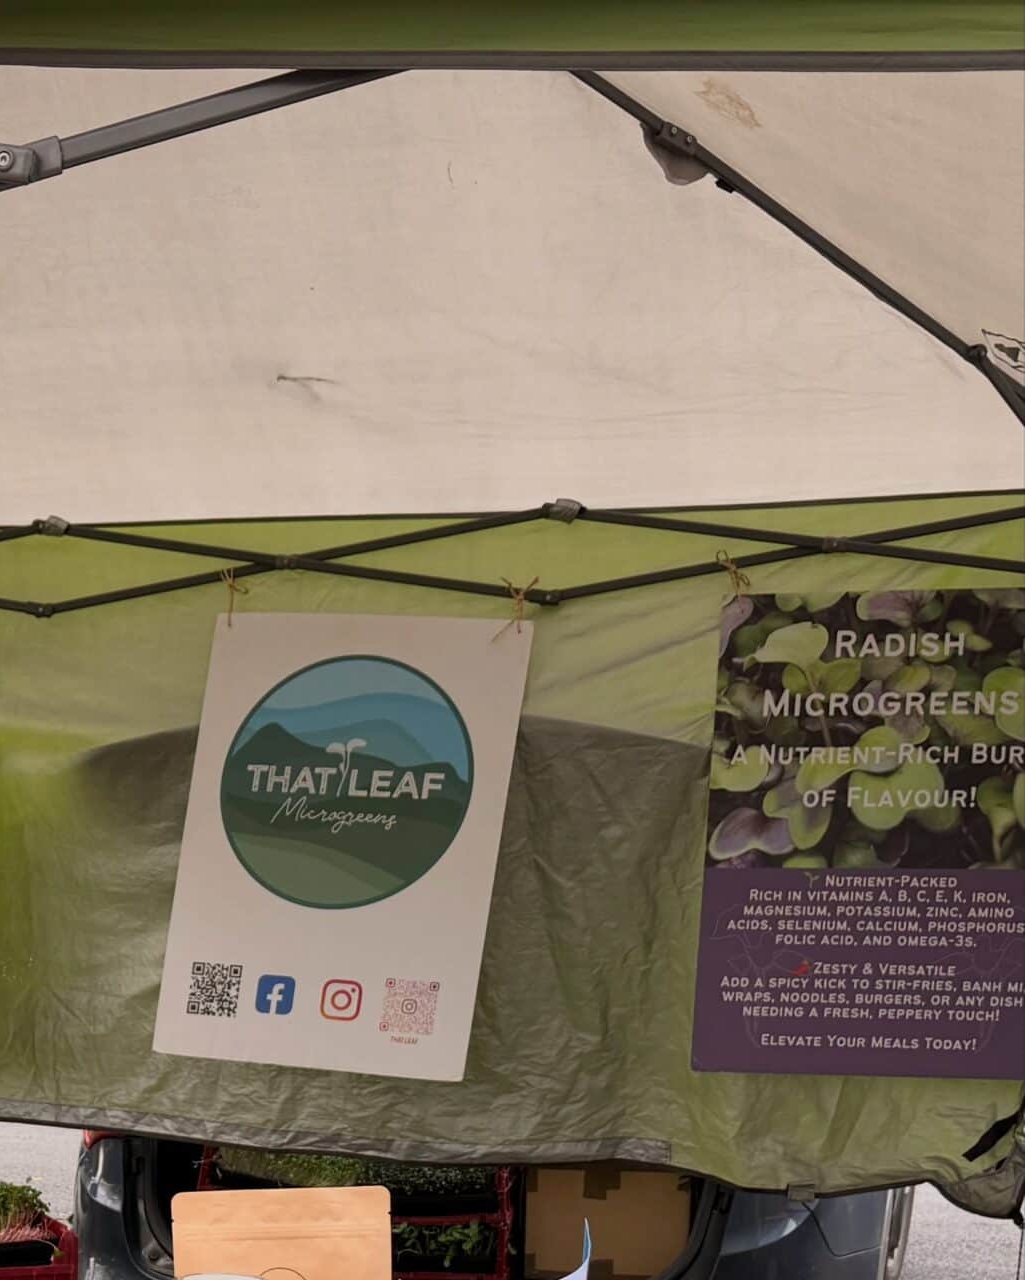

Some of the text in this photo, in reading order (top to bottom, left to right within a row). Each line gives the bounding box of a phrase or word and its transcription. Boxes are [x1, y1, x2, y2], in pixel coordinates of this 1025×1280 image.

[835, 630, 965, 657] RADISH
[762, 689, 1019, 717] MICROGREENS
[731, 747, 747, 765] A
[759, 743, 959, 765] NUTRIENT-RICH
[247, 764, 446, 800] THAT LEAF
[803, 786, 977, 808] OF FLAVOUR!
[270, 795, 398, 834] Microgreens
[825, 874, 957, 888] NUTRIENT-PACKED
[749, 888, 1010, 903] RICH IN VITAMINS A, B, C, E, K, IRON,
[743, 904, 1014, 918] MAGNESIUM, POTASSIUM, ZINC, AMINO
[726, 919, 772, 931] ACIDS,
[777, 919, 851, 931] SELENIUM,
[856, 920, 922, 932] CALCIUM,
[775, 933, 976, 947] FOLIC ACID, AND OMEGA-3S.
[813, 961, 956, 976] ZESTY & VERSATILE
[720, 975, 749, 987] ADD
[753, 977, 764, 987] A
[768, 977, 809, 988] SPICY
[813, 978, 846, 989] KICK
[851, 978, 869, 989] TO
[874, 979, 957, 992] STIR-FRIES,
[962, 981, 1002, 992] BANH
[722, 991, 1023, 1007] WRAPS, NOODLES, BURGERS, OR ANY DISH
[742, 1005, 1000, 1021] NEEDING A FRESH, PEPPERY TOUCH!
[760, 1033, 976, 1050] ELEVATE YOUR MEALS TODAY!
